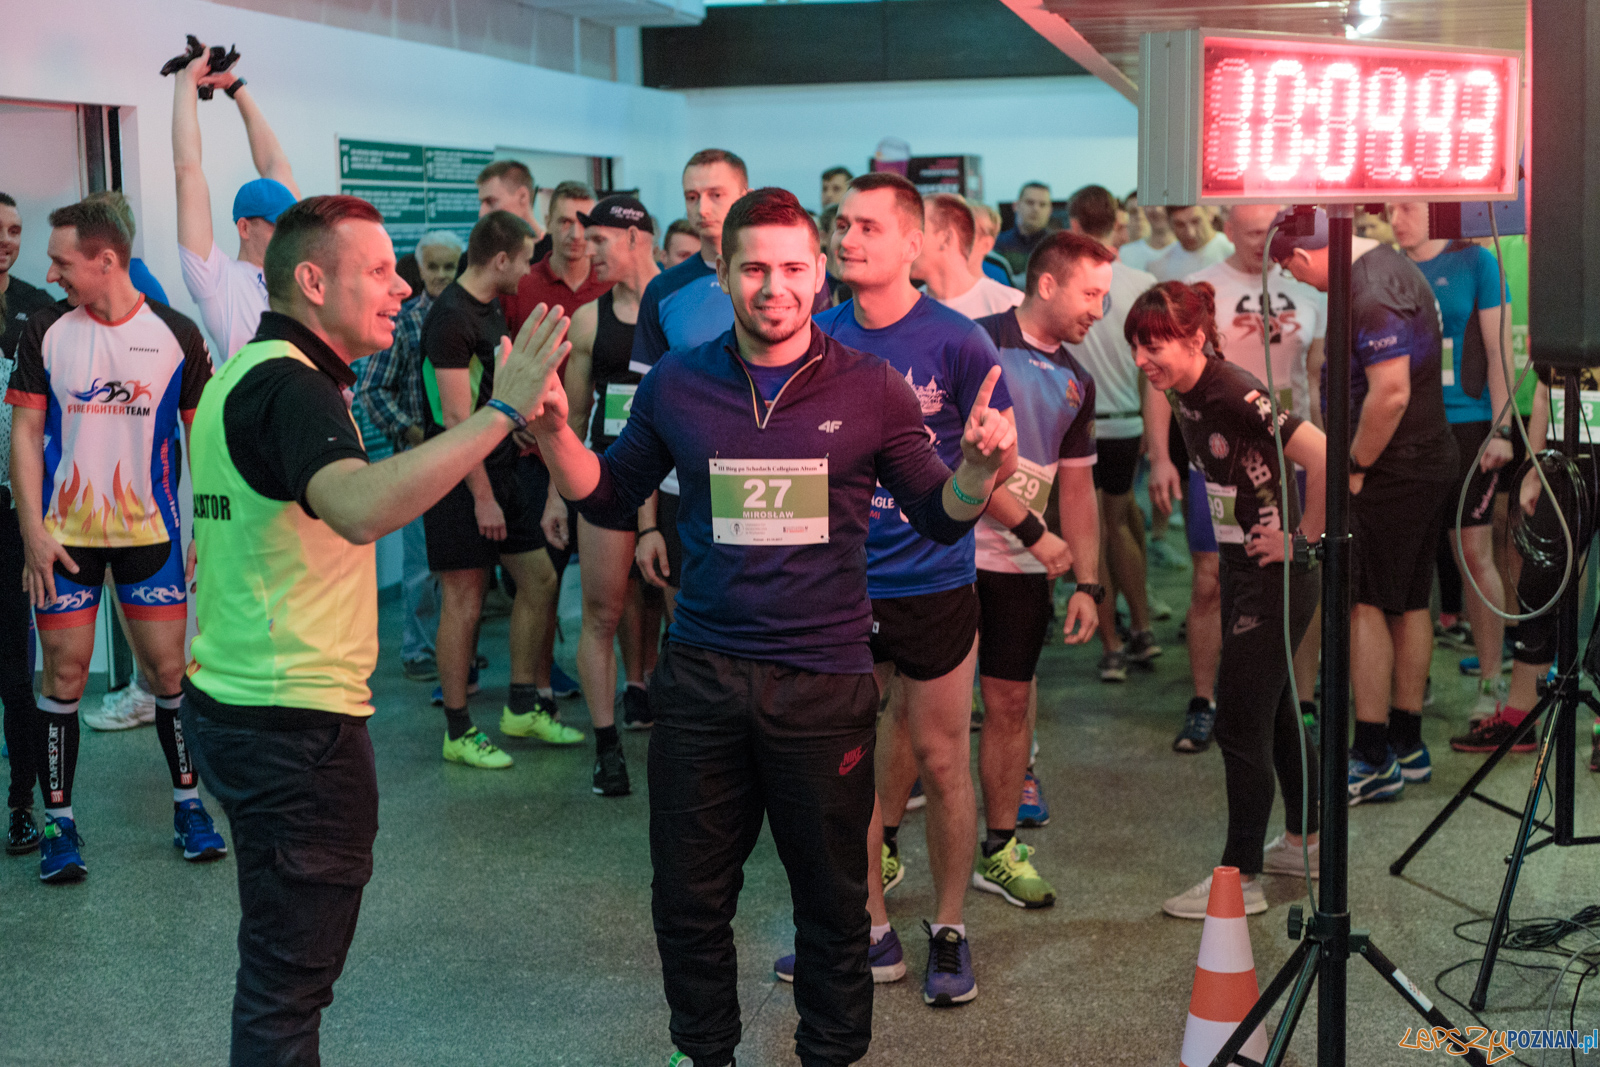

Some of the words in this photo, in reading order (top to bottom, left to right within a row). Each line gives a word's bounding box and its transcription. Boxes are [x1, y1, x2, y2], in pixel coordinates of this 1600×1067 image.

[67, 403, 151, 417] FIREFIGHTERTEAM
[818, 420, 843, 433] 4F
[772, 465, 800, 473] Collegium
[1007, 471, 1040, 500] 29
[743, 478, 792, 508] 27
[742, 510, 794, 519] MIROSŁAW
